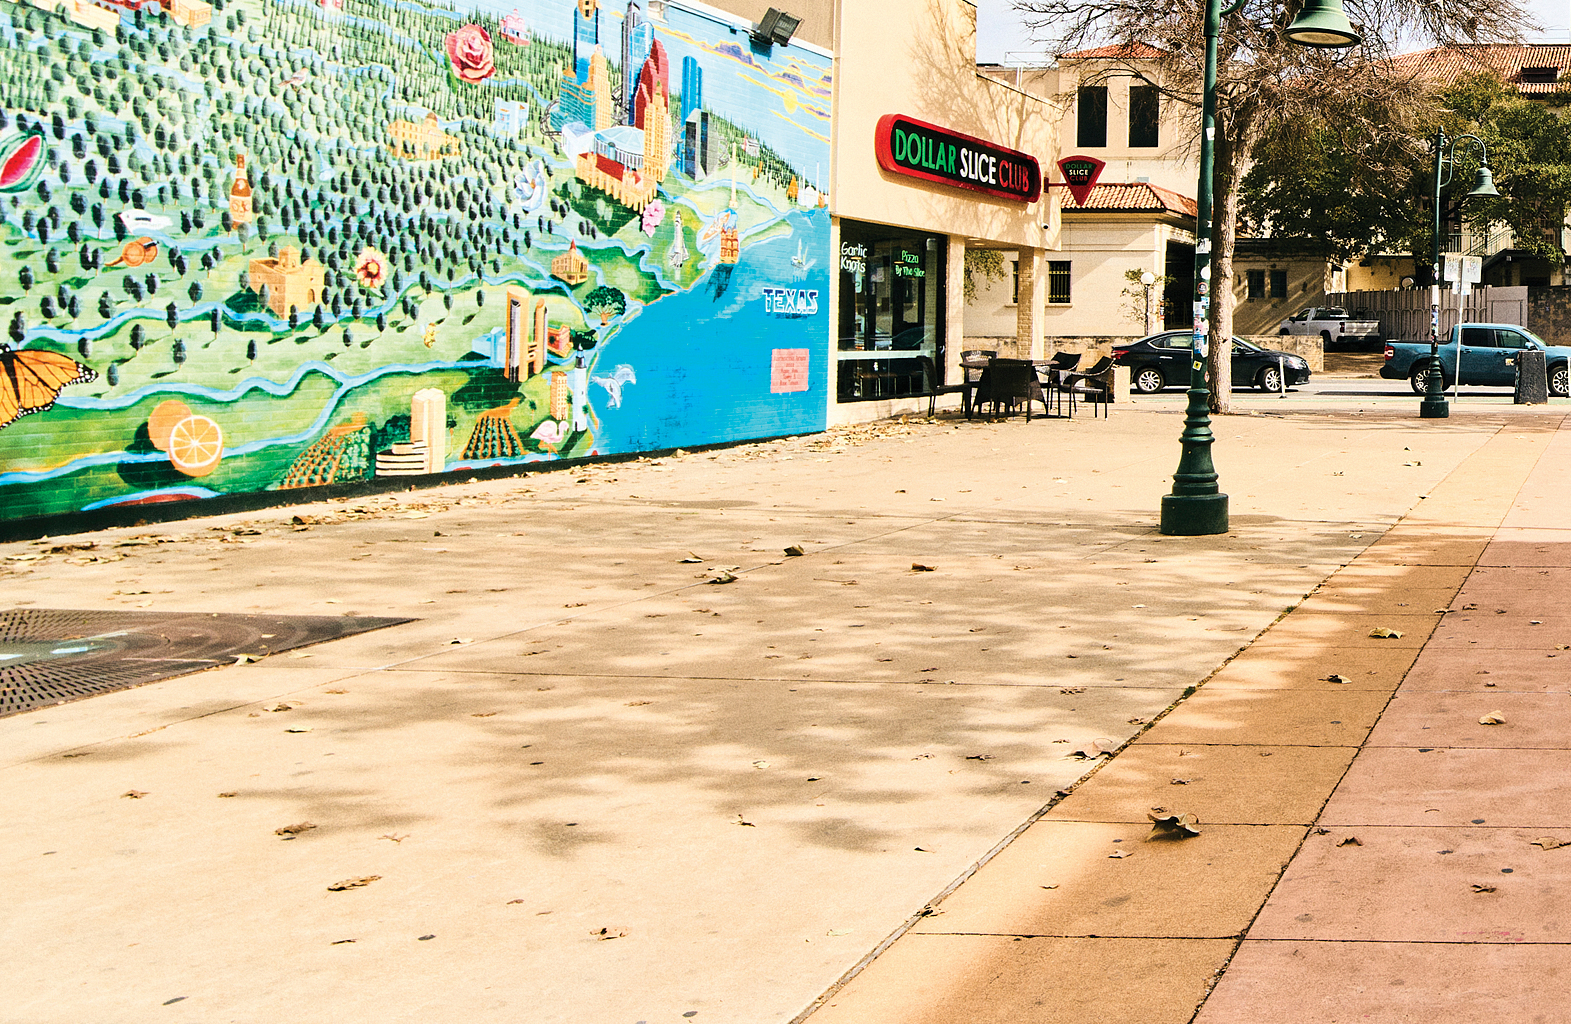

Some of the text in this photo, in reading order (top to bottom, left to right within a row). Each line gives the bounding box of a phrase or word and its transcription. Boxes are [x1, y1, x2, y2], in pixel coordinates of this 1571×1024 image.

[895, 128, 1029, 193] DOLLAR SLICE CLUB
[841, 241, 868, 258] Garlic
[901, 249, 919, 264] Pizza
[840, 255, 866, 273] Knots
[895, 264, 926, 278] By The Slice
[762, 288, 819, 315] TEXAS
